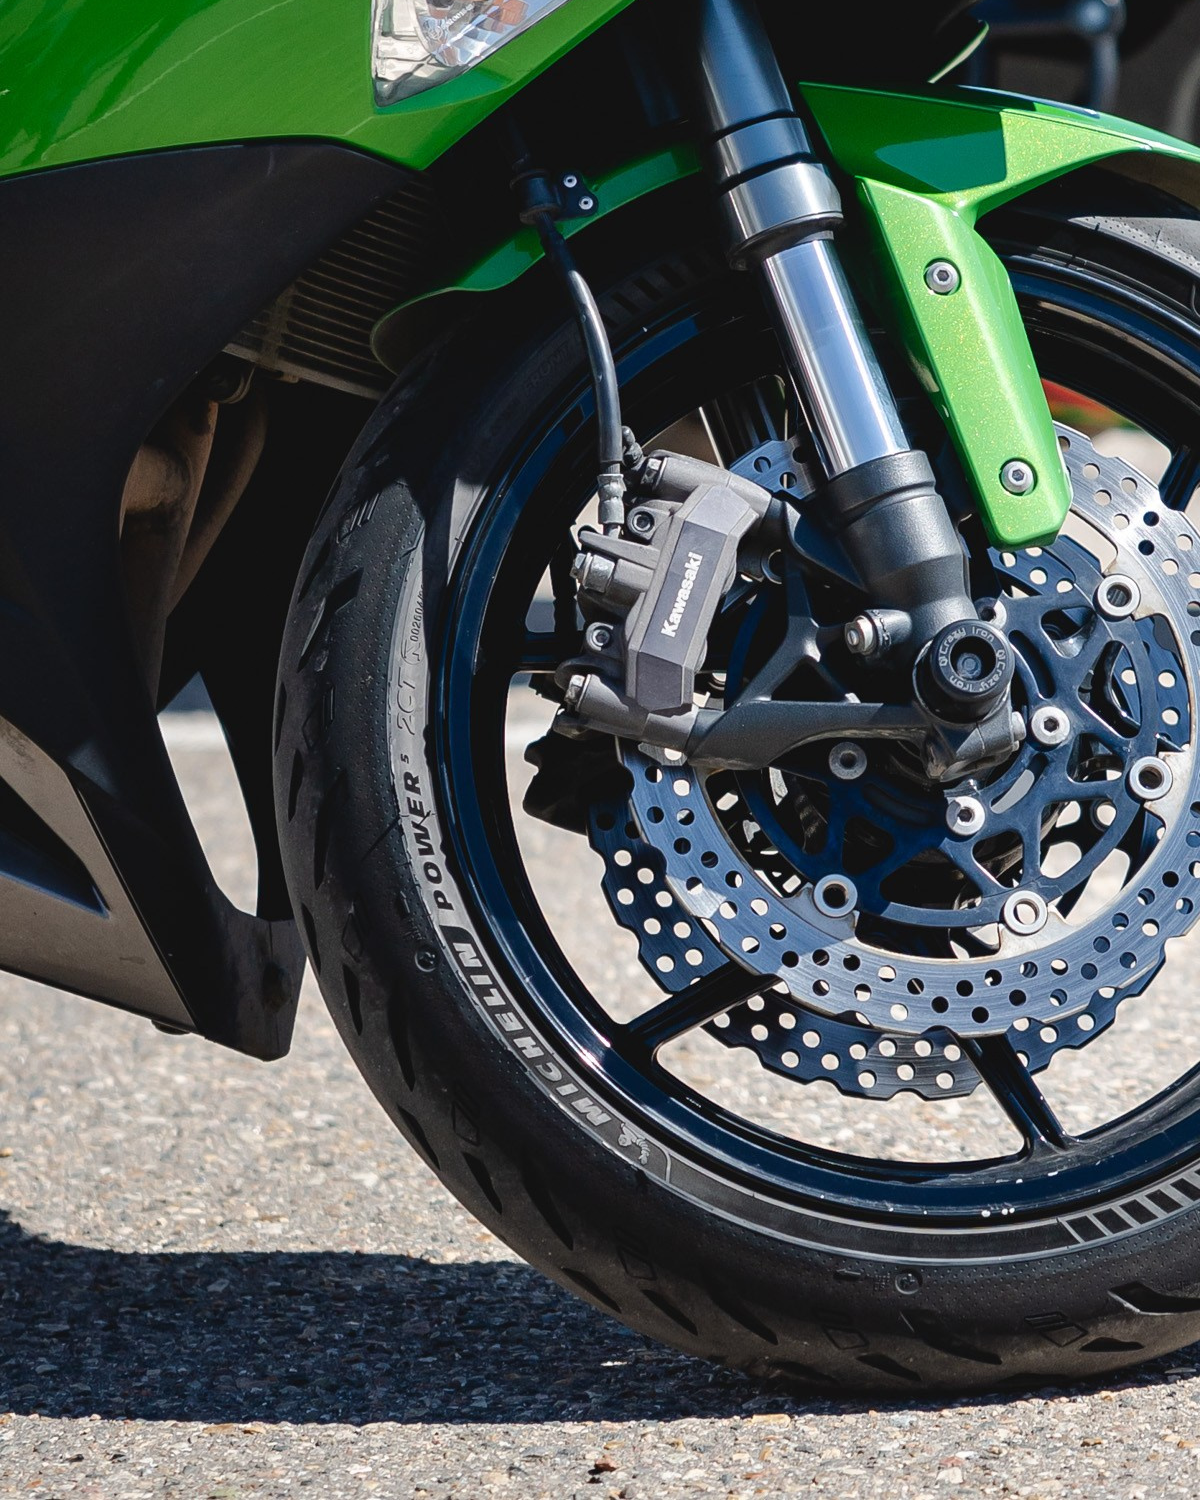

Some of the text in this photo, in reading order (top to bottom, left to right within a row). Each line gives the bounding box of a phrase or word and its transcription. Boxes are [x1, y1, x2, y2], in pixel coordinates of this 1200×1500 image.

[660, 552, 703, 638] Kawasaki
[939, 626, 995, 655] Crazy Iron
[401, 753, 410, 764] 5
[403, 771, 455, 911] POWER
[451, 940, 612, 1127] MICHELIN
